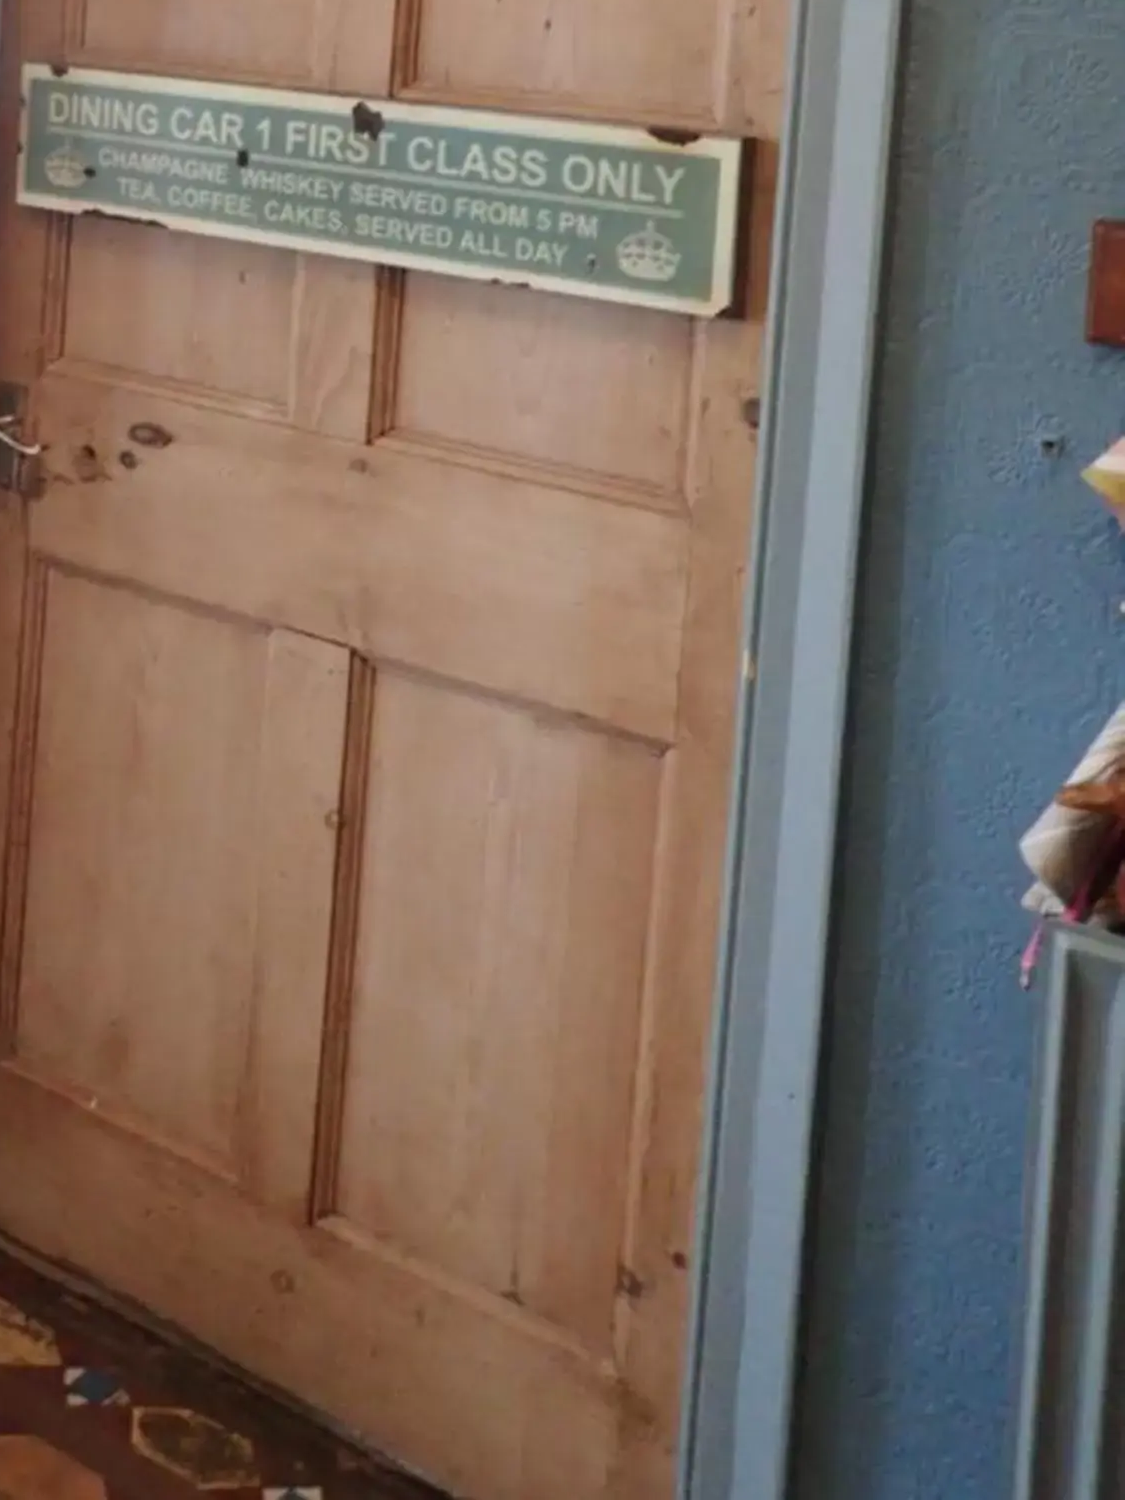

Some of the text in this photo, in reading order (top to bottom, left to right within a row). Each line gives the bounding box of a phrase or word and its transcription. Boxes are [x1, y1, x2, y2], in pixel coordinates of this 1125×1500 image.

[48, 91, 685, 205] DINING CAR 1 FIRST CLASS ONLY
[98, 145, 599, 240] CHAMPAGNE WHISKEY SERVED FROM 5 PM
[354, 213, 453, 248] SERVED
[458, 228, 509, 258] ALL
[515, 239, 570, 268] DAY
